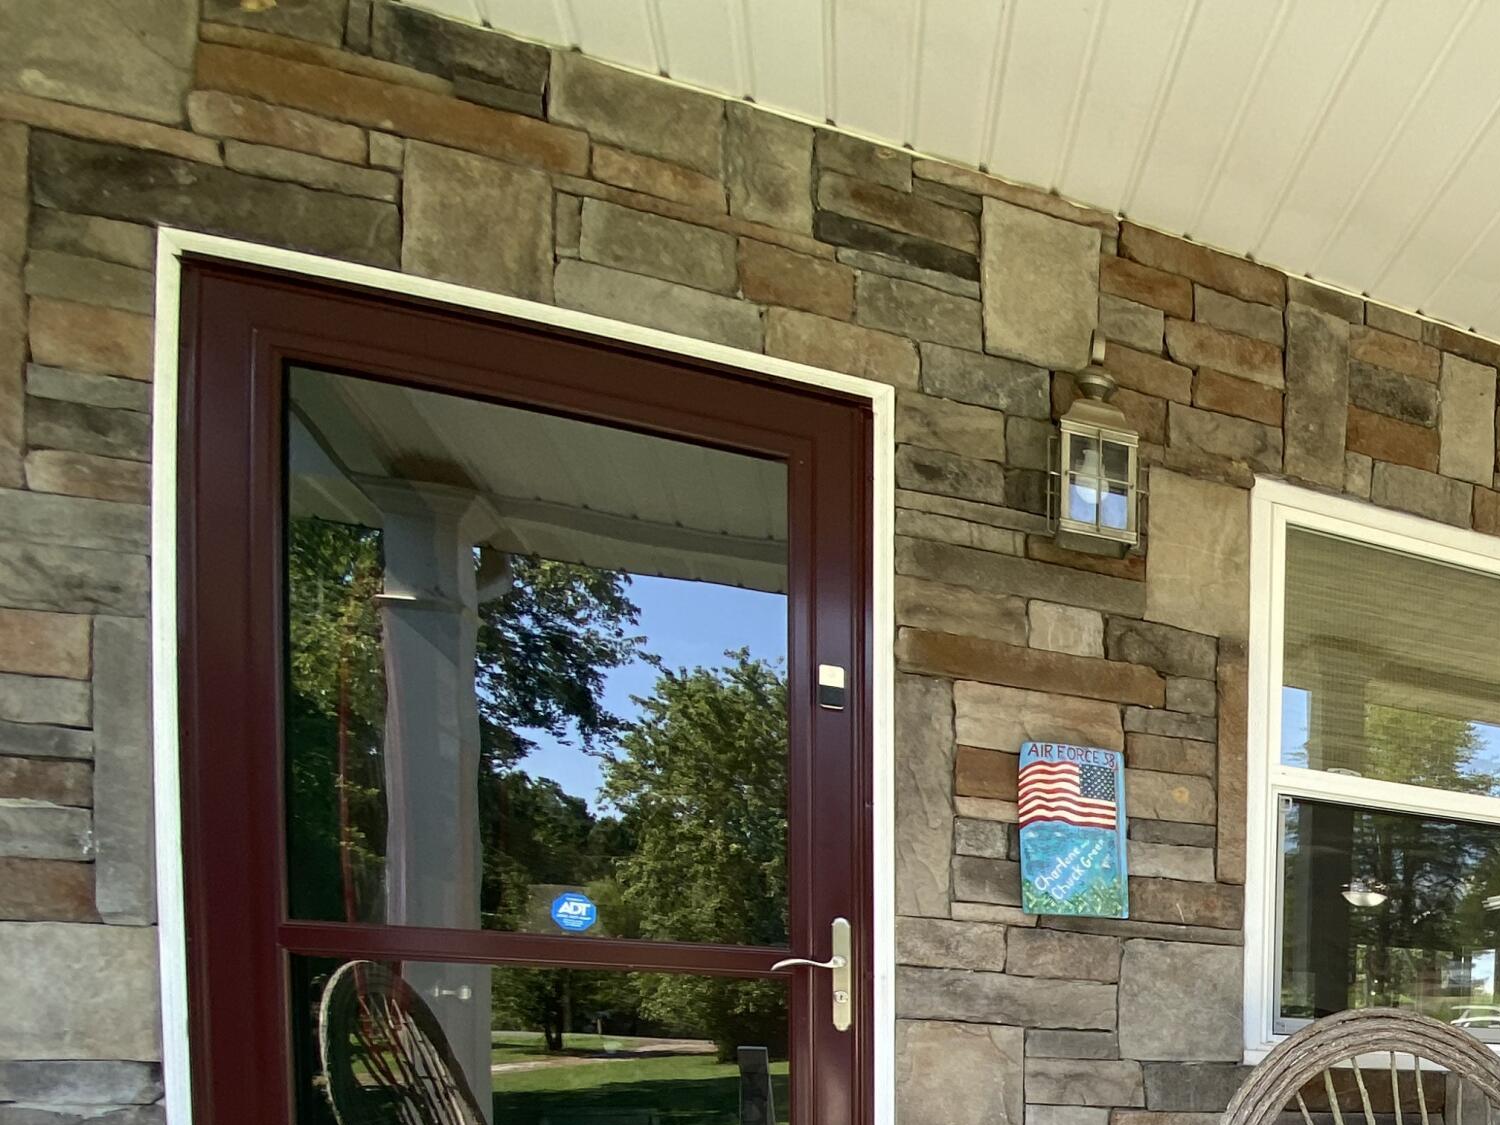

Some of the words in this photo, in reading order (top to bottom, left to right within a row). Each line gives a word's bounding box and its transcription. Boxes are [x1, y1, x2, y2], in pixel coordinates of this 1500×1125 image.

[1028, 743, 1054, 758] AIR
[1057, 745, 1098, 764] FORCE
[558, 901, 591, 916] ADT
